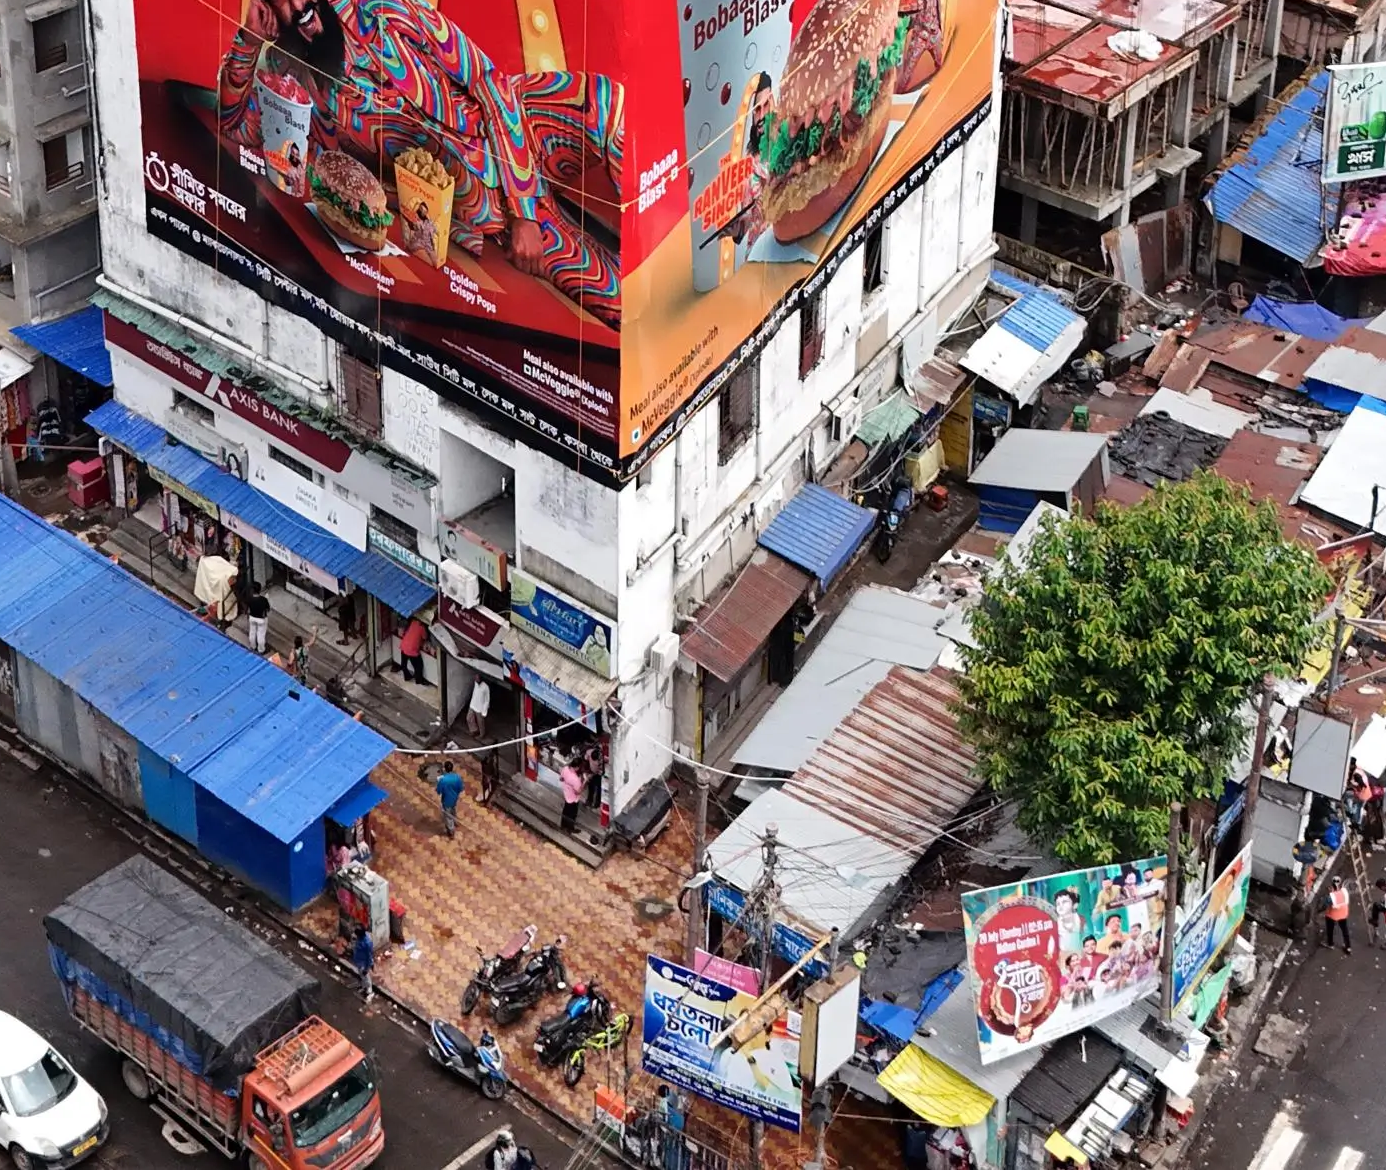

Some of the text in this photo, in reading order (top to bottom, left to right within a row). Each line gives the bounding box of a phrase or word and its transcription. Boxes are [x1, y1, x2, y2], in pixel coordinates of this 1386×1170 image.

[171, 163, 247, 223] সীমিত সময়ের
[639, 148, 678, 194] Bobaaa
[693, 157, 754, 221] RANVEER
[172, 184, 207, 216] অফার
[638, 177, 666, 214] Blast
[702, 184, 745, 232] SINGH
[449, 269, 479, 293] Golden
[449, 281, 497, 314] Crispy Pops
[522, 348, 614, 404] Meal also available with
[629, 392, 651, 420] Meal
[651, 378, 667, 401] also
[668, 347, 701, 385] available
[700, 326, 719, 349] with
[229, 387, 300, 437] AXIS BANK
